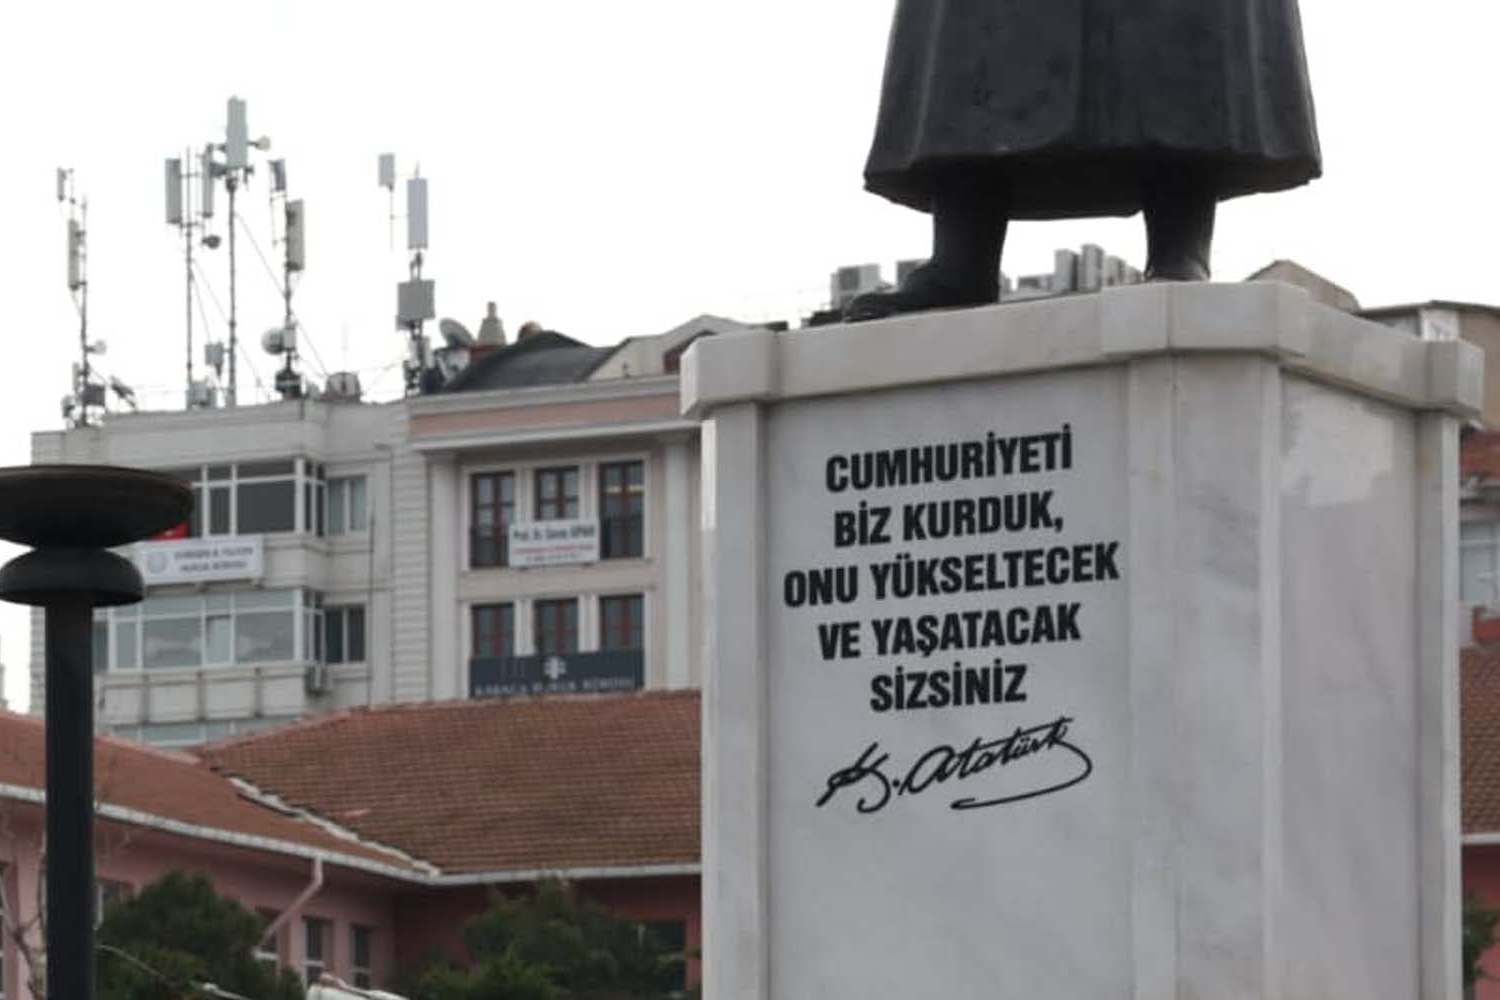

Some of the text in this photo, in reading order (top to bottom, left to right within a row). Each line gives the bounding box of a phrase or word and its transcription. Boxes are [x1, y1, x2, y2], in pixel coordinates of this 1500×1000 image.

[825, 423, 1073, 494] CUMHURİYETİ
[834, 490, 1064, 548] BİZ KURDUK,
[783, 540, 1120, 609] ONU YÜKSELTECEK
[817, 602, 1082, 661] VE YAŞATACAK
[869, 658, 1028, 713] SİZSİNİZ
